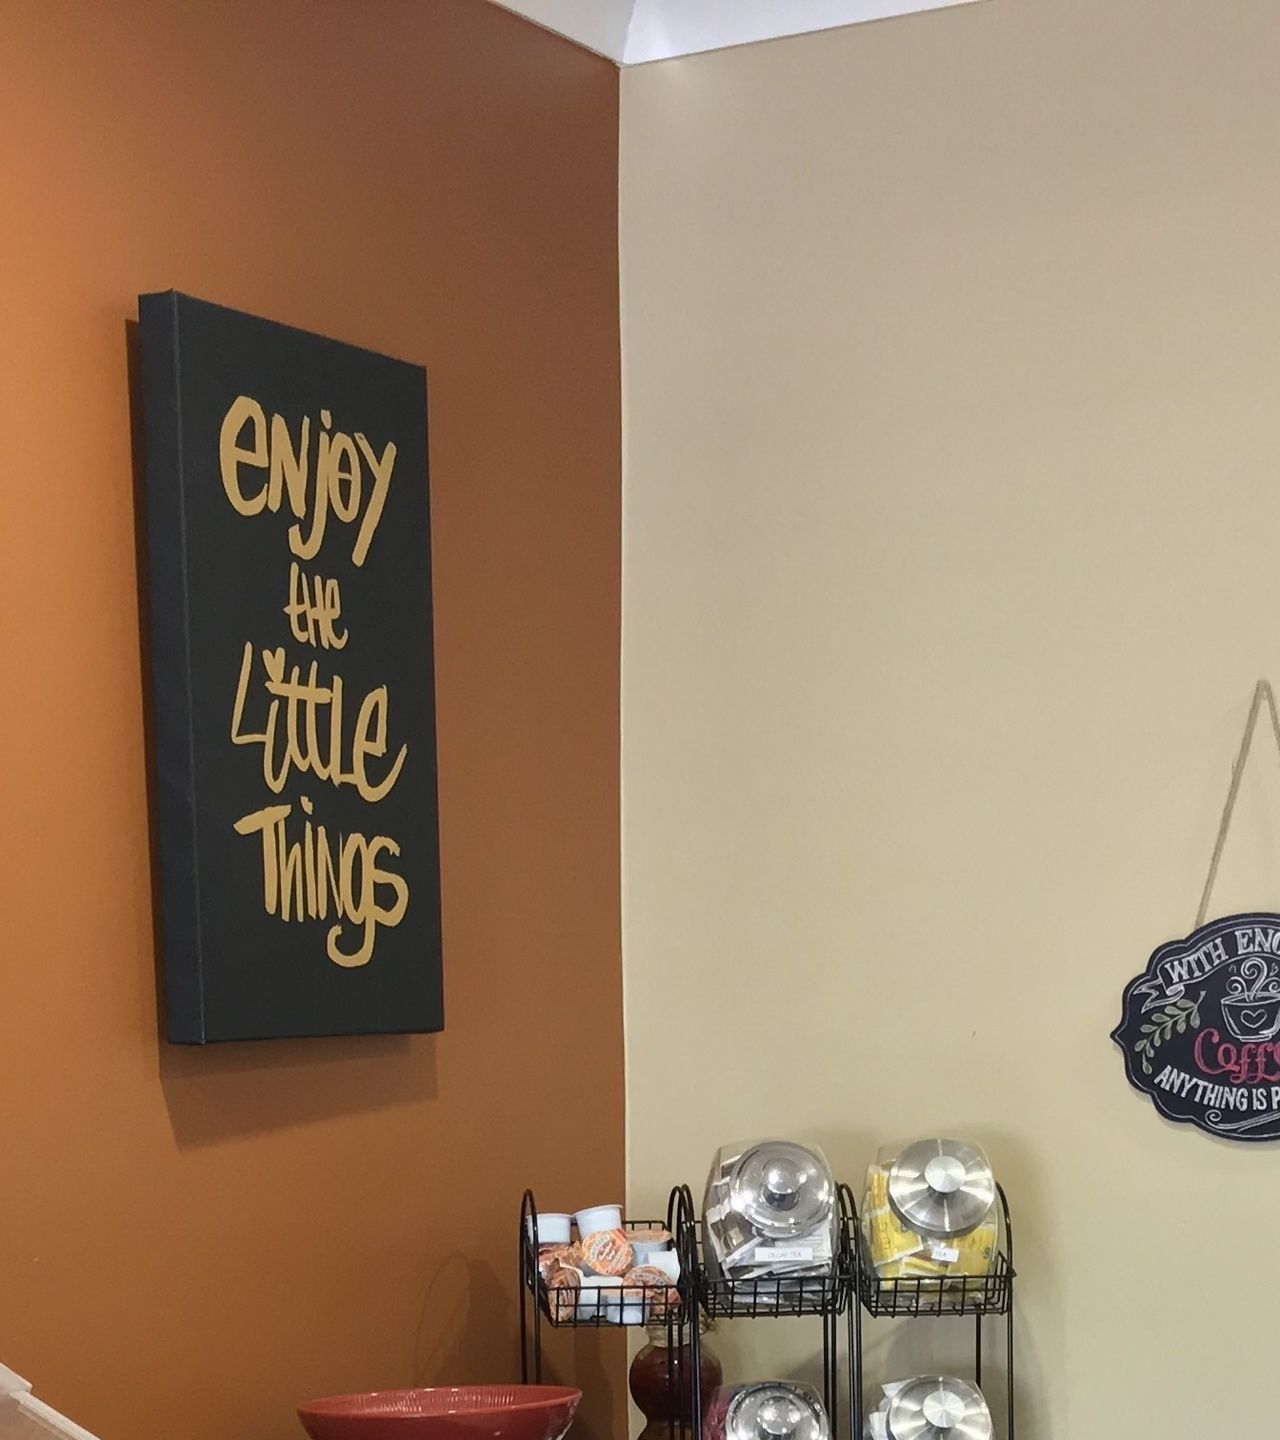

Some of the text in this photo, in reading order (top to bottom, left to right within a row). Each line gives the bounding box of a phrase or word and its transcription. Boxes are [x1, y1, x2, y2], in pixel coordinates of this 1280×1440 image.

[1164, 938, 1229, 984] WITH
[1153, 1064, 1249, 1112] ANYTHING
[1252, 1087, 1269, 1111] IS
